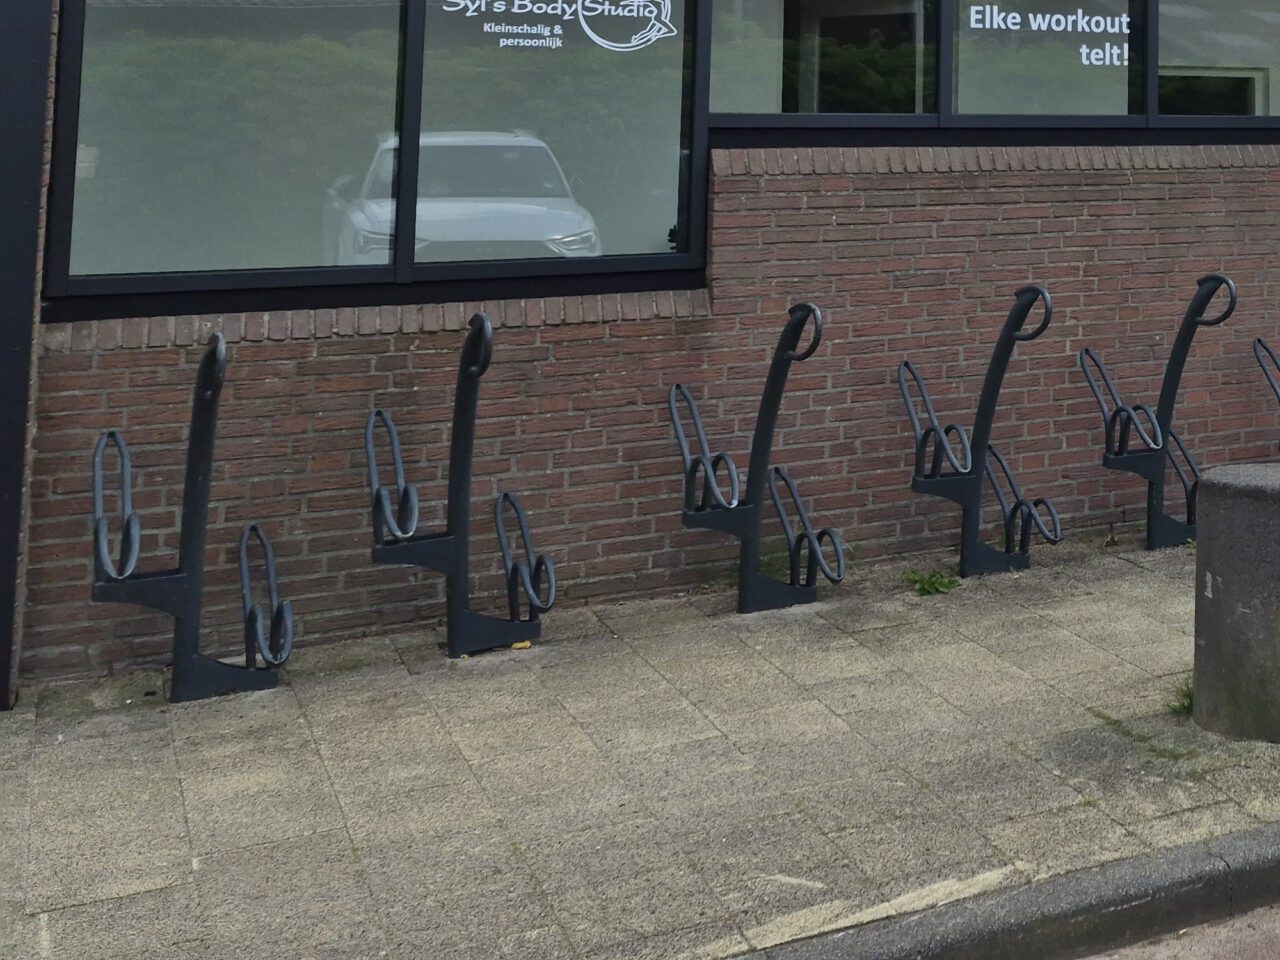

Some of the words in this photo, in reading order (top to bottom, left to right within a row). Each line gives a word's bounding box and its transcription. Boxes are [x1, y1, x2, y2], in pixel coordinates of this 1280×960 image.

[483, 22, 551, 36] Kleinschalig
[553, 24, 563, 35] &
[969, 5, 1022, 30] Elke
[1028, 8, 1131, 34] workout
[499, 36, 563, 49] persoonlijk
[1079, 42, 1129, 66] telt!
